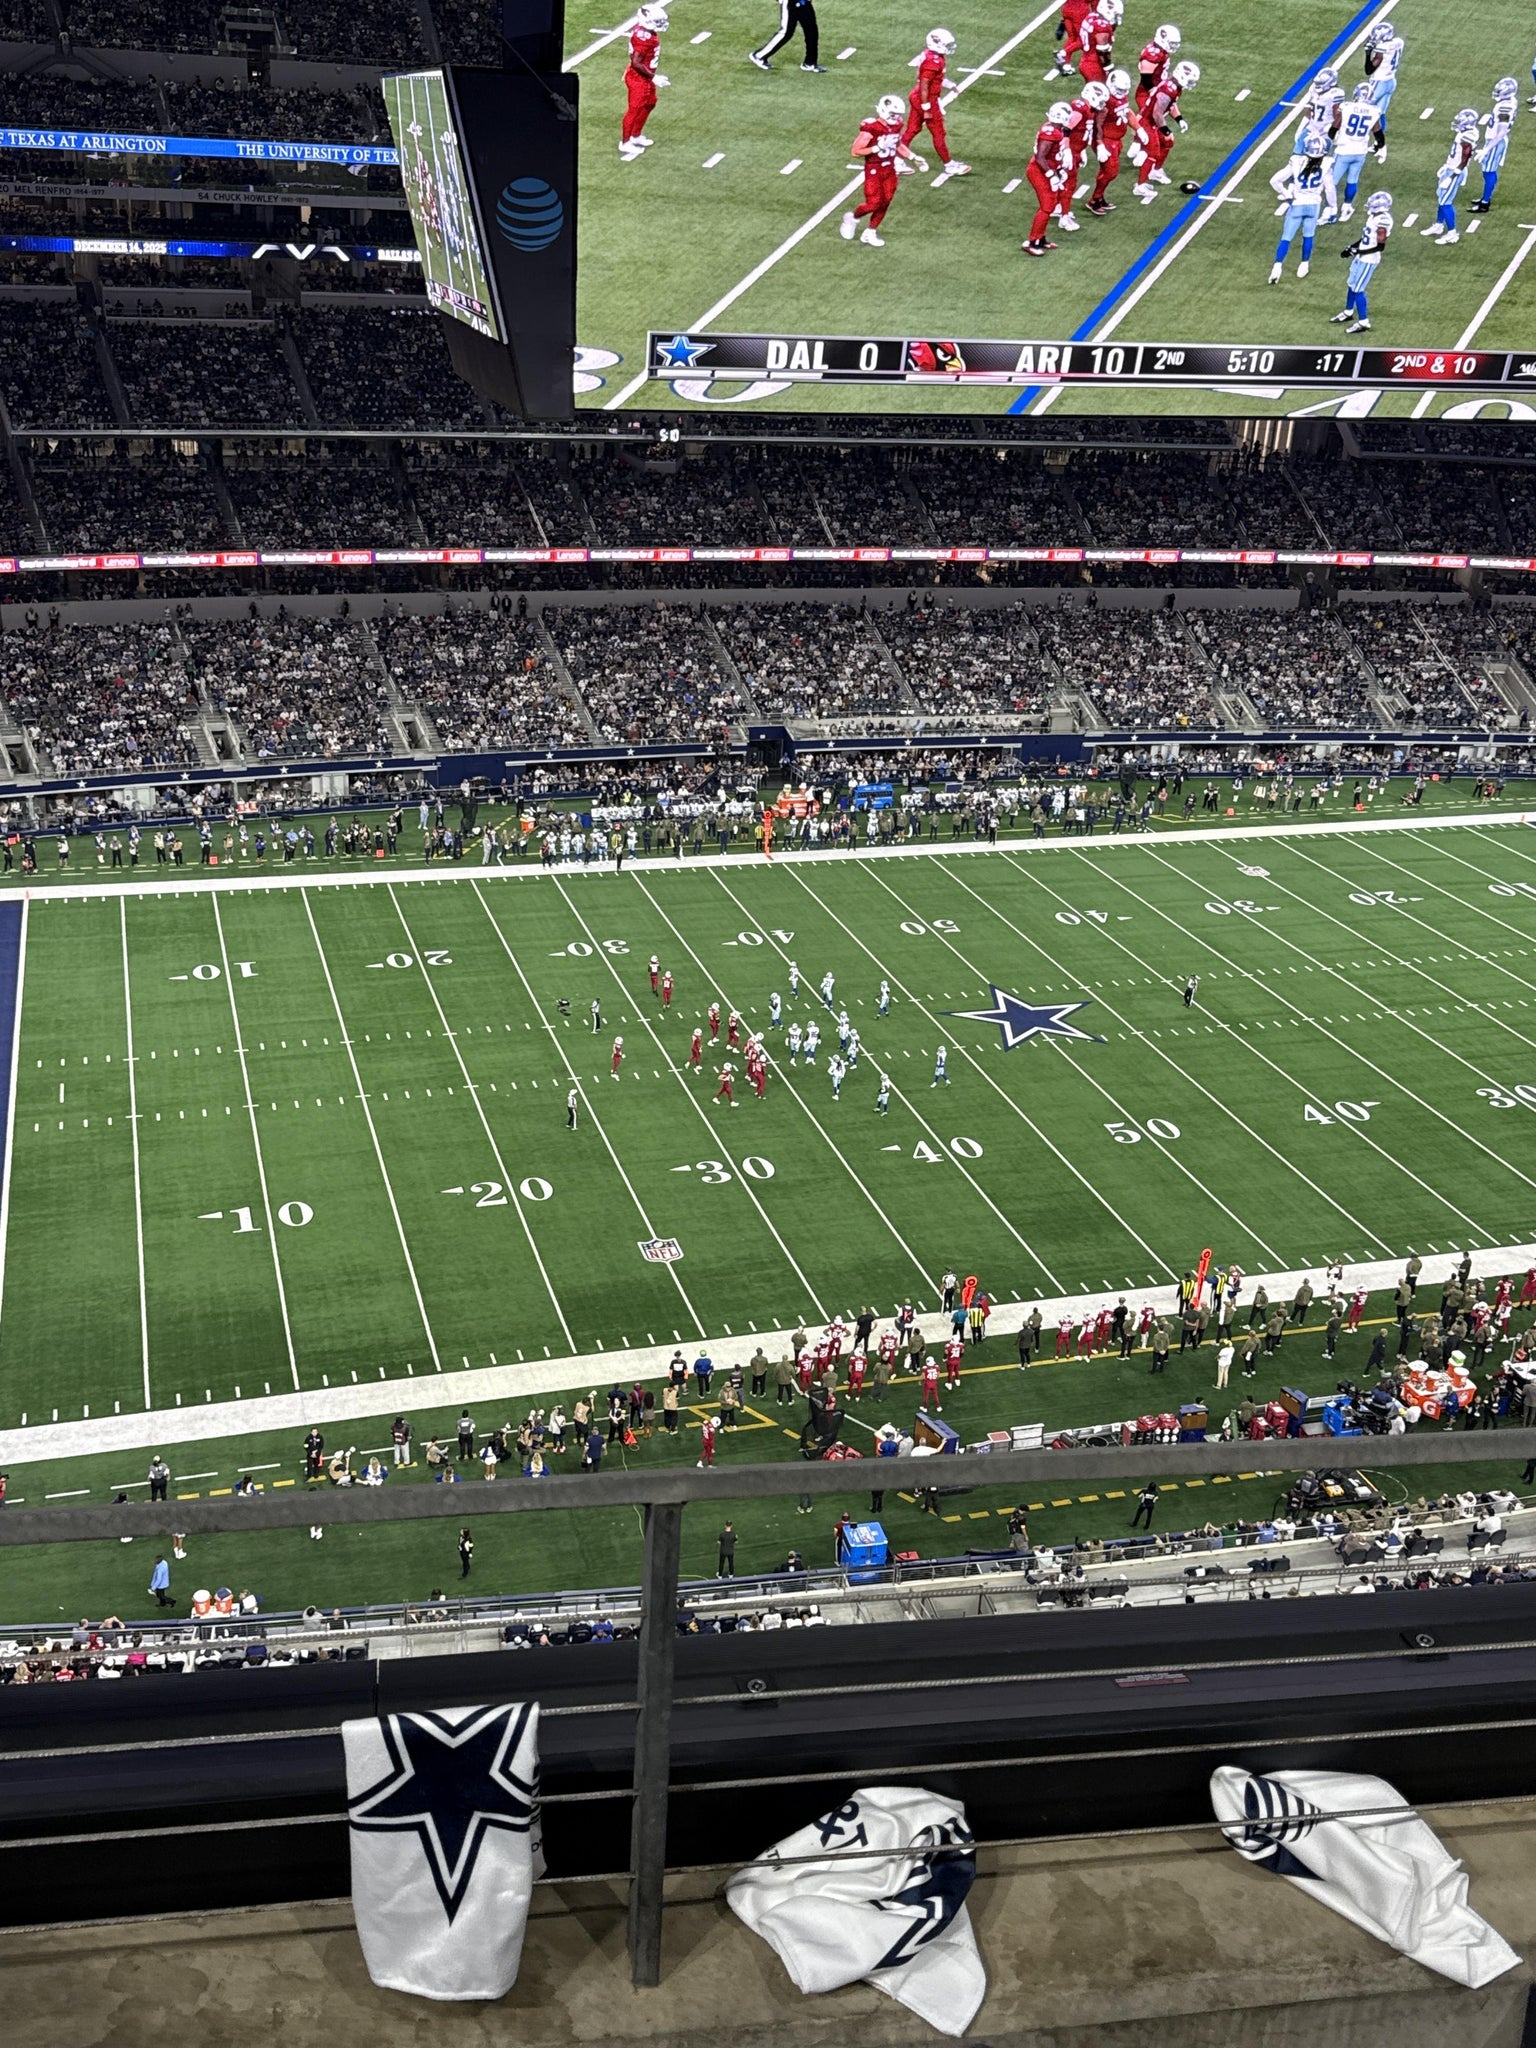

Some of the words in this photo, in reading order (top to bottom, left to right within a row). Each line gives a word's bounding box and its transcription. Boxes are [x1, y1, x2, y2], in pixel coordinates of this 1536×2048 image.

[1345, 114, 1372, 137] 95
[8, 133, 55, 147] TEXAS
[59, 136, 76, 147] AT
[82, 136, 167, 151] ARLINGTON
[236, 143, 265, 156] THE
[268, 145, 350, 161] UNIVERSITY
[353, 149, 371, 162] OF
[1297, 171, 1323, 189] 42
[14, 185, 33, 194] MEL
[35, 186, 72, 196] RENFRO
[213, 193, 242, 202] CHUCK
[243, 194, 279, 204] HOWLEY
[74, 240, 127, 253] DECEMBER
[128, 241, 142, 254] 14,
[143, 241, 167, 254] 2025
[378, 249, 413, 261] DALLAS
[766, 340, 828, 370] DAL
[859, 343, 879, 371] 0
[1015, 345, 1073, 374] ARI
[1091, 347, 1125, 375] 10
[1153, 350, 1185, 370] 2ND
[1227, 350, 1275, 373] 5:10
[1315, 353, 1344, 372] :17
[1391, 355, 1427, 373] 2ND
[1431, 356, 1446, 373] &
[1453, 357, 1477, 374] 10
[1204, 899, 1264, 915] 30
[1348, 890, 1408, 906] 20
[1055, 909, 1109, 926] 40
[900, 919, 961, 936] 50
[738, 929, 795, 946] 40
[567, 939, 631, 957] 30
[386, 950, 453, 969] 20
[192, 961, 259, 980] 10
[1475, 1084, 1536, 1109] 30
[1304, 1100, 1371, 1126] 40
[1104, 1118, 1182, 1144] 50
[912, 1136, 984, 1164] 40
[696, 1156, 776, 1184] 30
[470, 1177, 554, 1208] 20
[229, 1201, 315, 1234] 10
[648, 1248, 678, 1260] NFL
[1423, 1400, 1437, 1416] G
